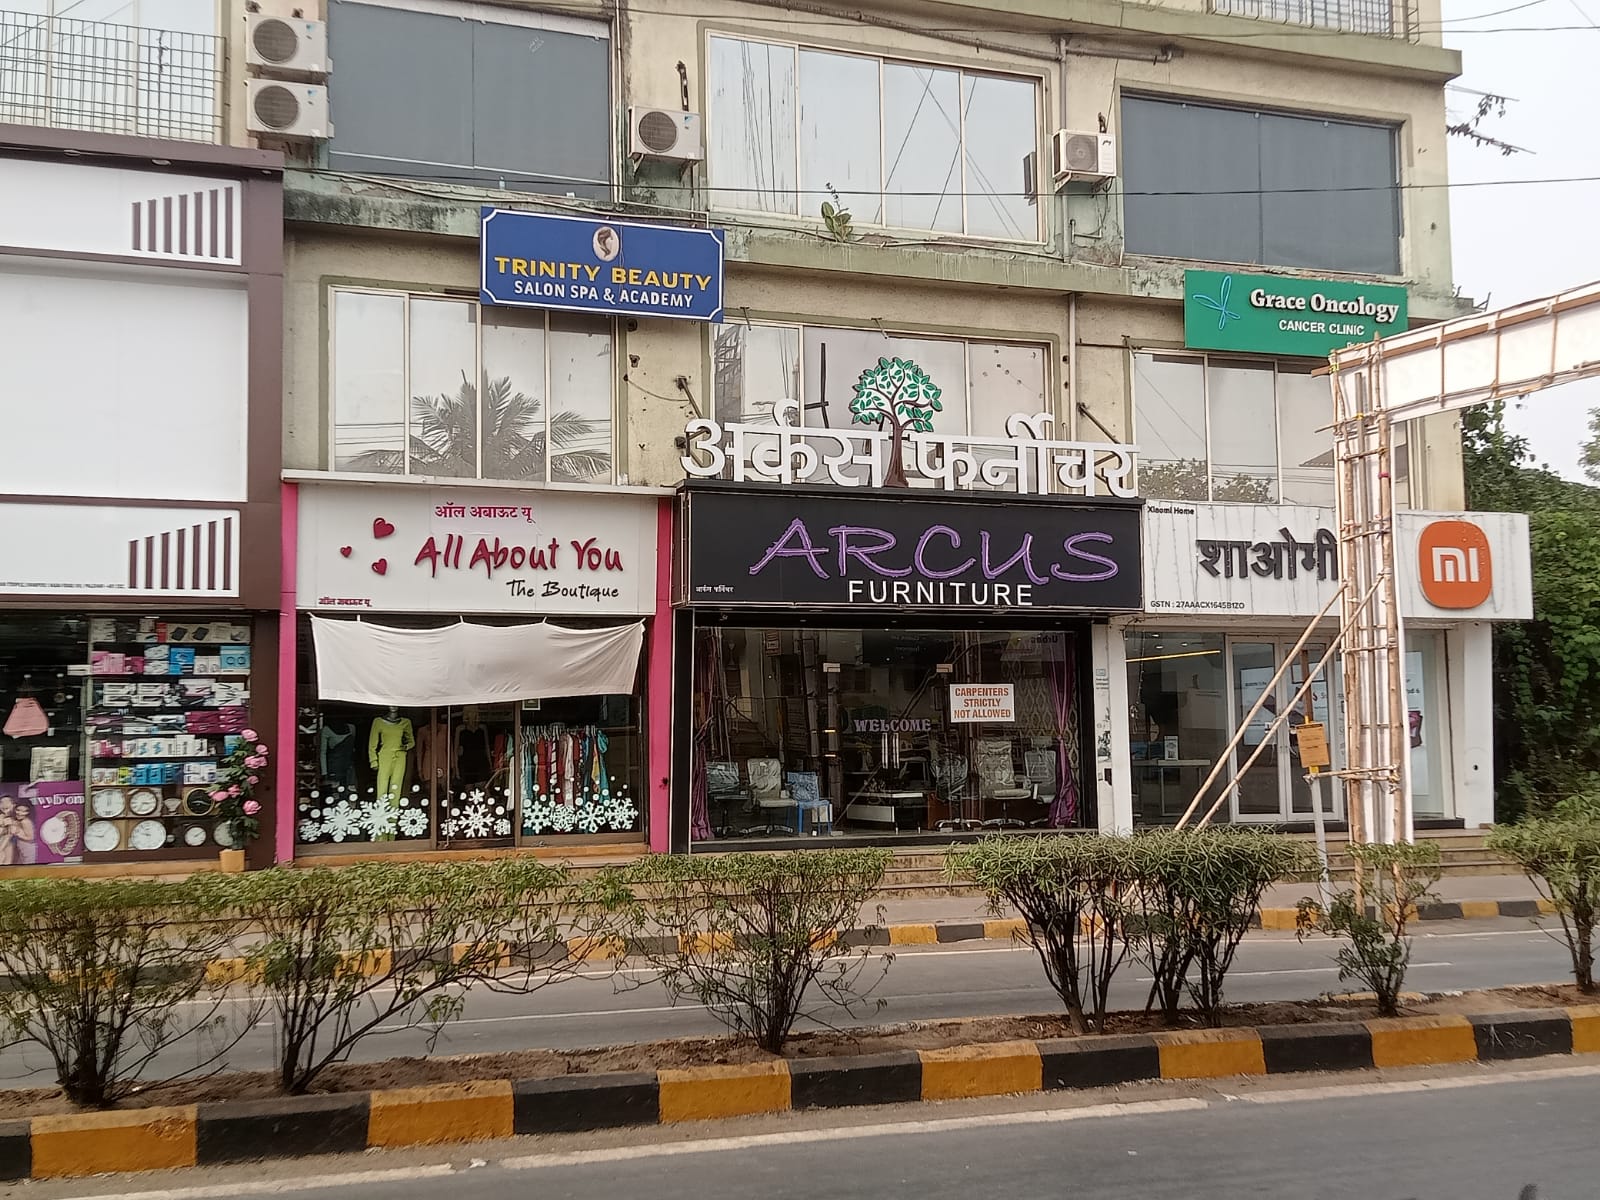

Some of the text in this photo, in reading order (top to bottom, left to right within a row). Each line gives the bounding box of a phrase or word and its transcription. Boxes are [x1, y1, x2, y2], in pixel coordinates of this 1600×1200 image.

[494, 256, 713, 291] TRINITY BEAUTY
[514, 280, 694, 308] SALON SPA & ACADEMY
[1250, 288, 1400, 323] Grace Oncology
[1278, 319, 1366, 337] CANCER CLINIC
[680, 398, 1141, 499] अर्कस फर्नीचर
[434, 501, 537, 524] ऑल अबाऊट यू
[1147, 505, 1195, 516] Xiaomi Home
[414, 533, 624, 579] All About You
[749, 518, 1119, 585] ARCUS
[506, 579, 620, 602] The Boutique
[848, 579, 1033, 606] FURNITURE
[1150, 600, 1171, 608] GSTN
[955, 687, 1009, 697] CARPENTERS
[963, 698, 1001, 708] STRICTLY
[853, 718, 932, 733] WELCOME
[954, 709, 1011, 719] NOT ALLOWED
